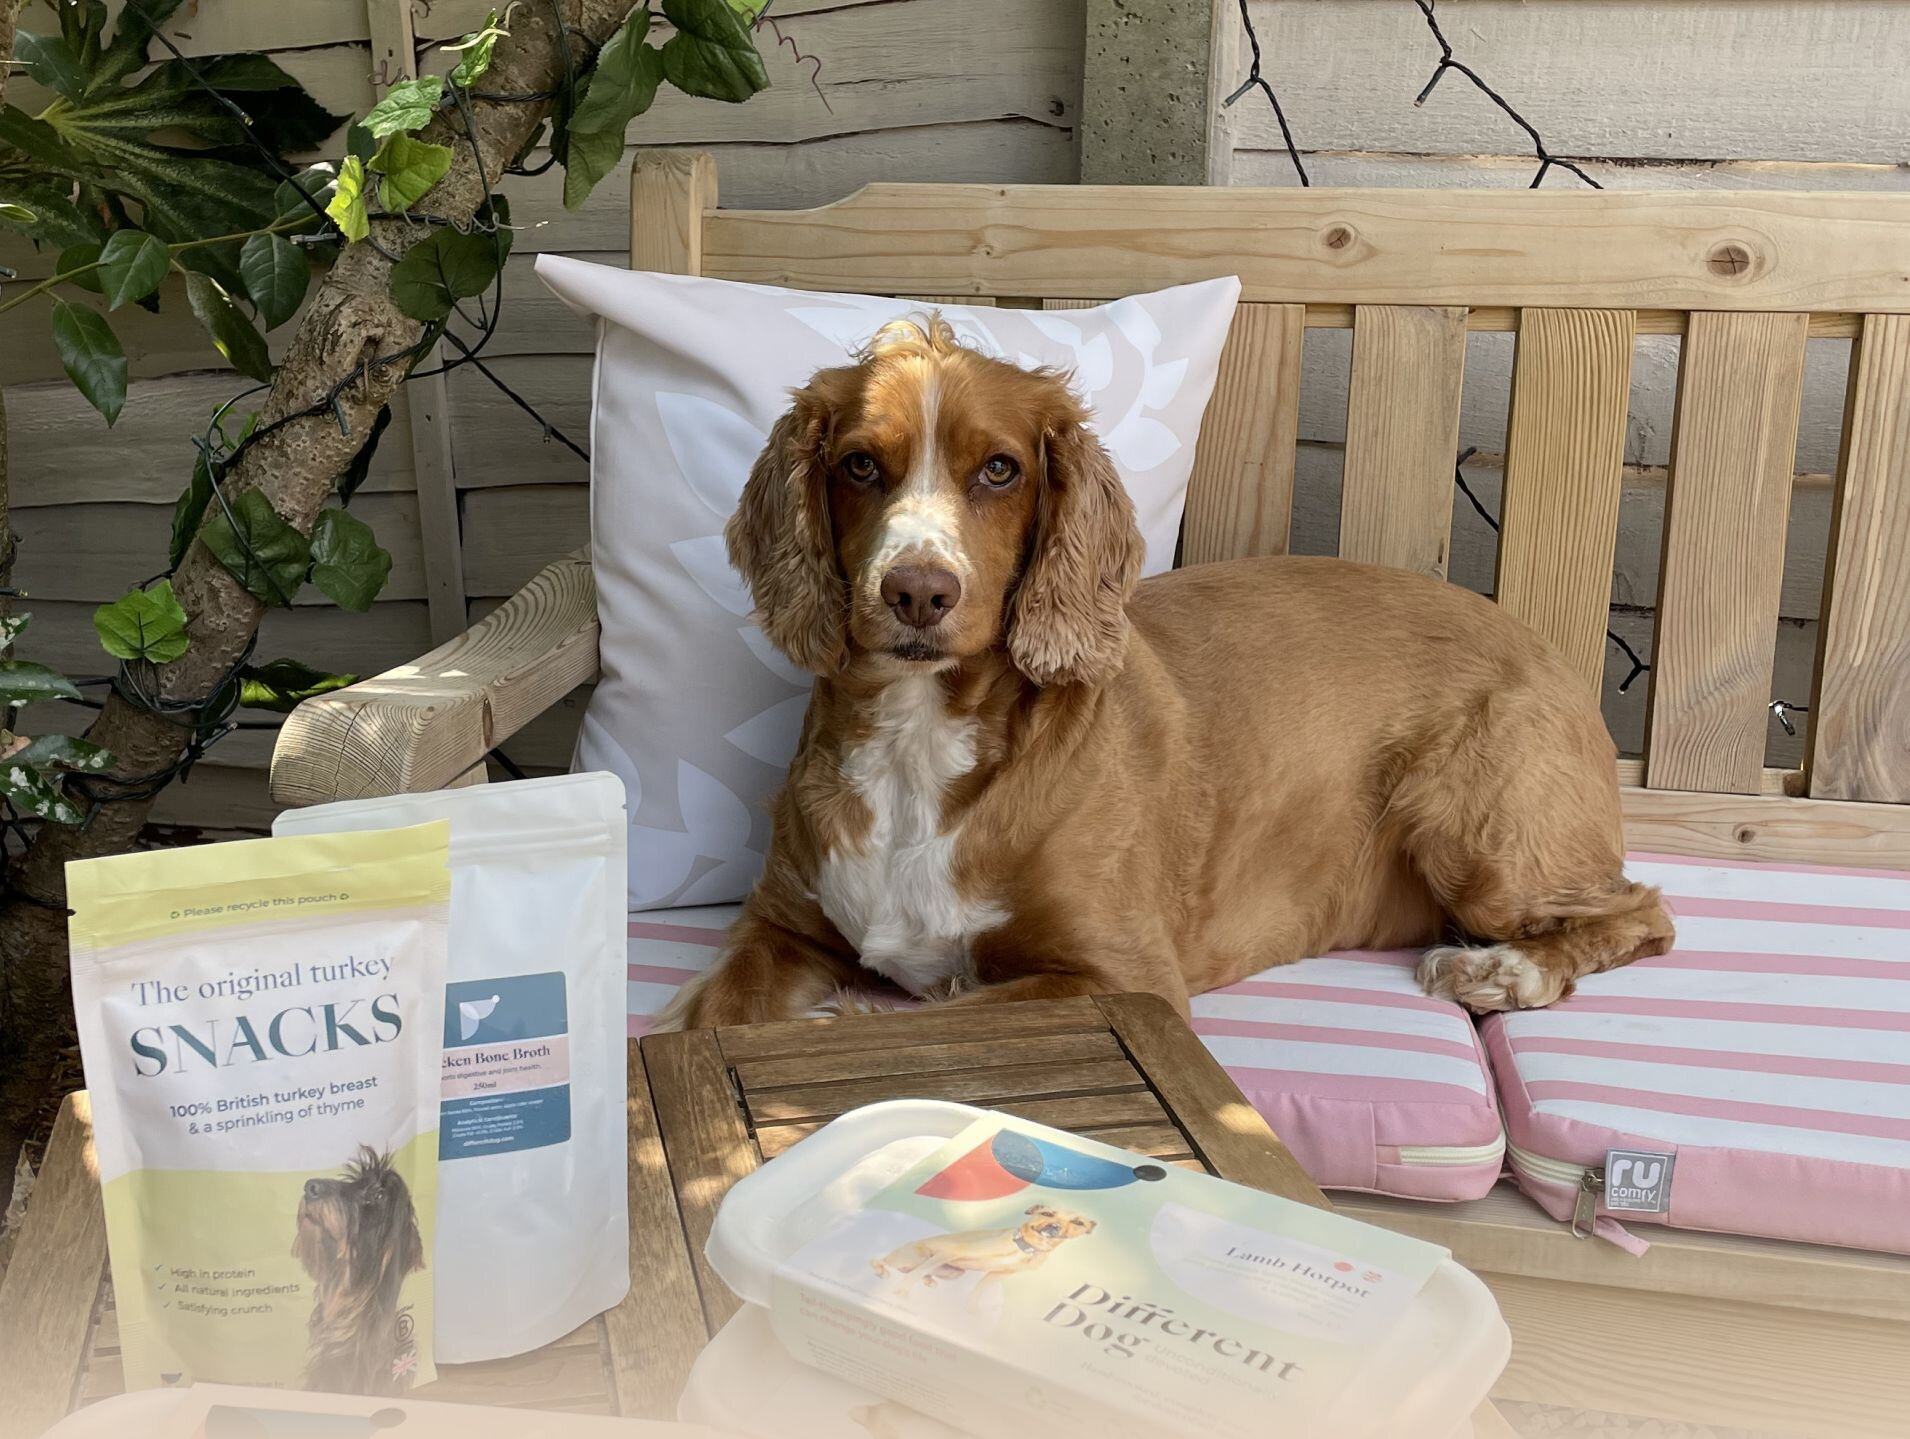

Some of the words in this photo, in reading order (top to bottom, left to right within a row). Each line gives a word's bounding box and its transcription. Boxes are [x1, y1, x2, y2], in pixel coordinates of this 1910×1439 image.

[184, 905, 223, 918] Please
[227, 900, 269, 912] recycle
[273, 897, 295, 907] this
[298, 893, 337, 905] pouch
[131, 979, 191, 1007] The
[198, 963, 302, 1001] original
[310, 955, 395, 984] turkey
[130, 993, 402, 1078] SNACKS
[441, 1056, 471, 1068] cken
[475, 1052, 509, 1065] Bone
[513, 1045, 551, 1060] Broth
[170, 1101, 213, 1119] 100%
[217, 1093, 270, 1113] British
[274, 1085, 326, 1104] turkey
[329, 1076, 378, 1095] breast
[188, 1121, 199, 1135] &
[203, 1123, 213, 1133] a
[217, 1108, 294, 1132] sprinkling
[298, 1104, 314, 1118] of
[317, 1098, 366, 1116] thyme
[1611, 1187, 1657, 1203] comfy
[170, 1267, 197, 1280] High
[199, 1268, 210, 1279] in
[213, 1268, 256, 1281] protein
[174, 1284, 189, 1294] All
[191, 1286, 229, 1297] natural
[232, 1283, 300, 1298] ingredients
[1226, 1246, 1286, 1269] Lamb
[1291, 1263, 1373, 1299] Hotpot
[178, 1300, 229, 1316] Satisfying
[230, 1303, 273, 1314] crunch
[1043, 1301, 1152, 1360] Dog
[1068, 1283, 1305, 1381] Different
